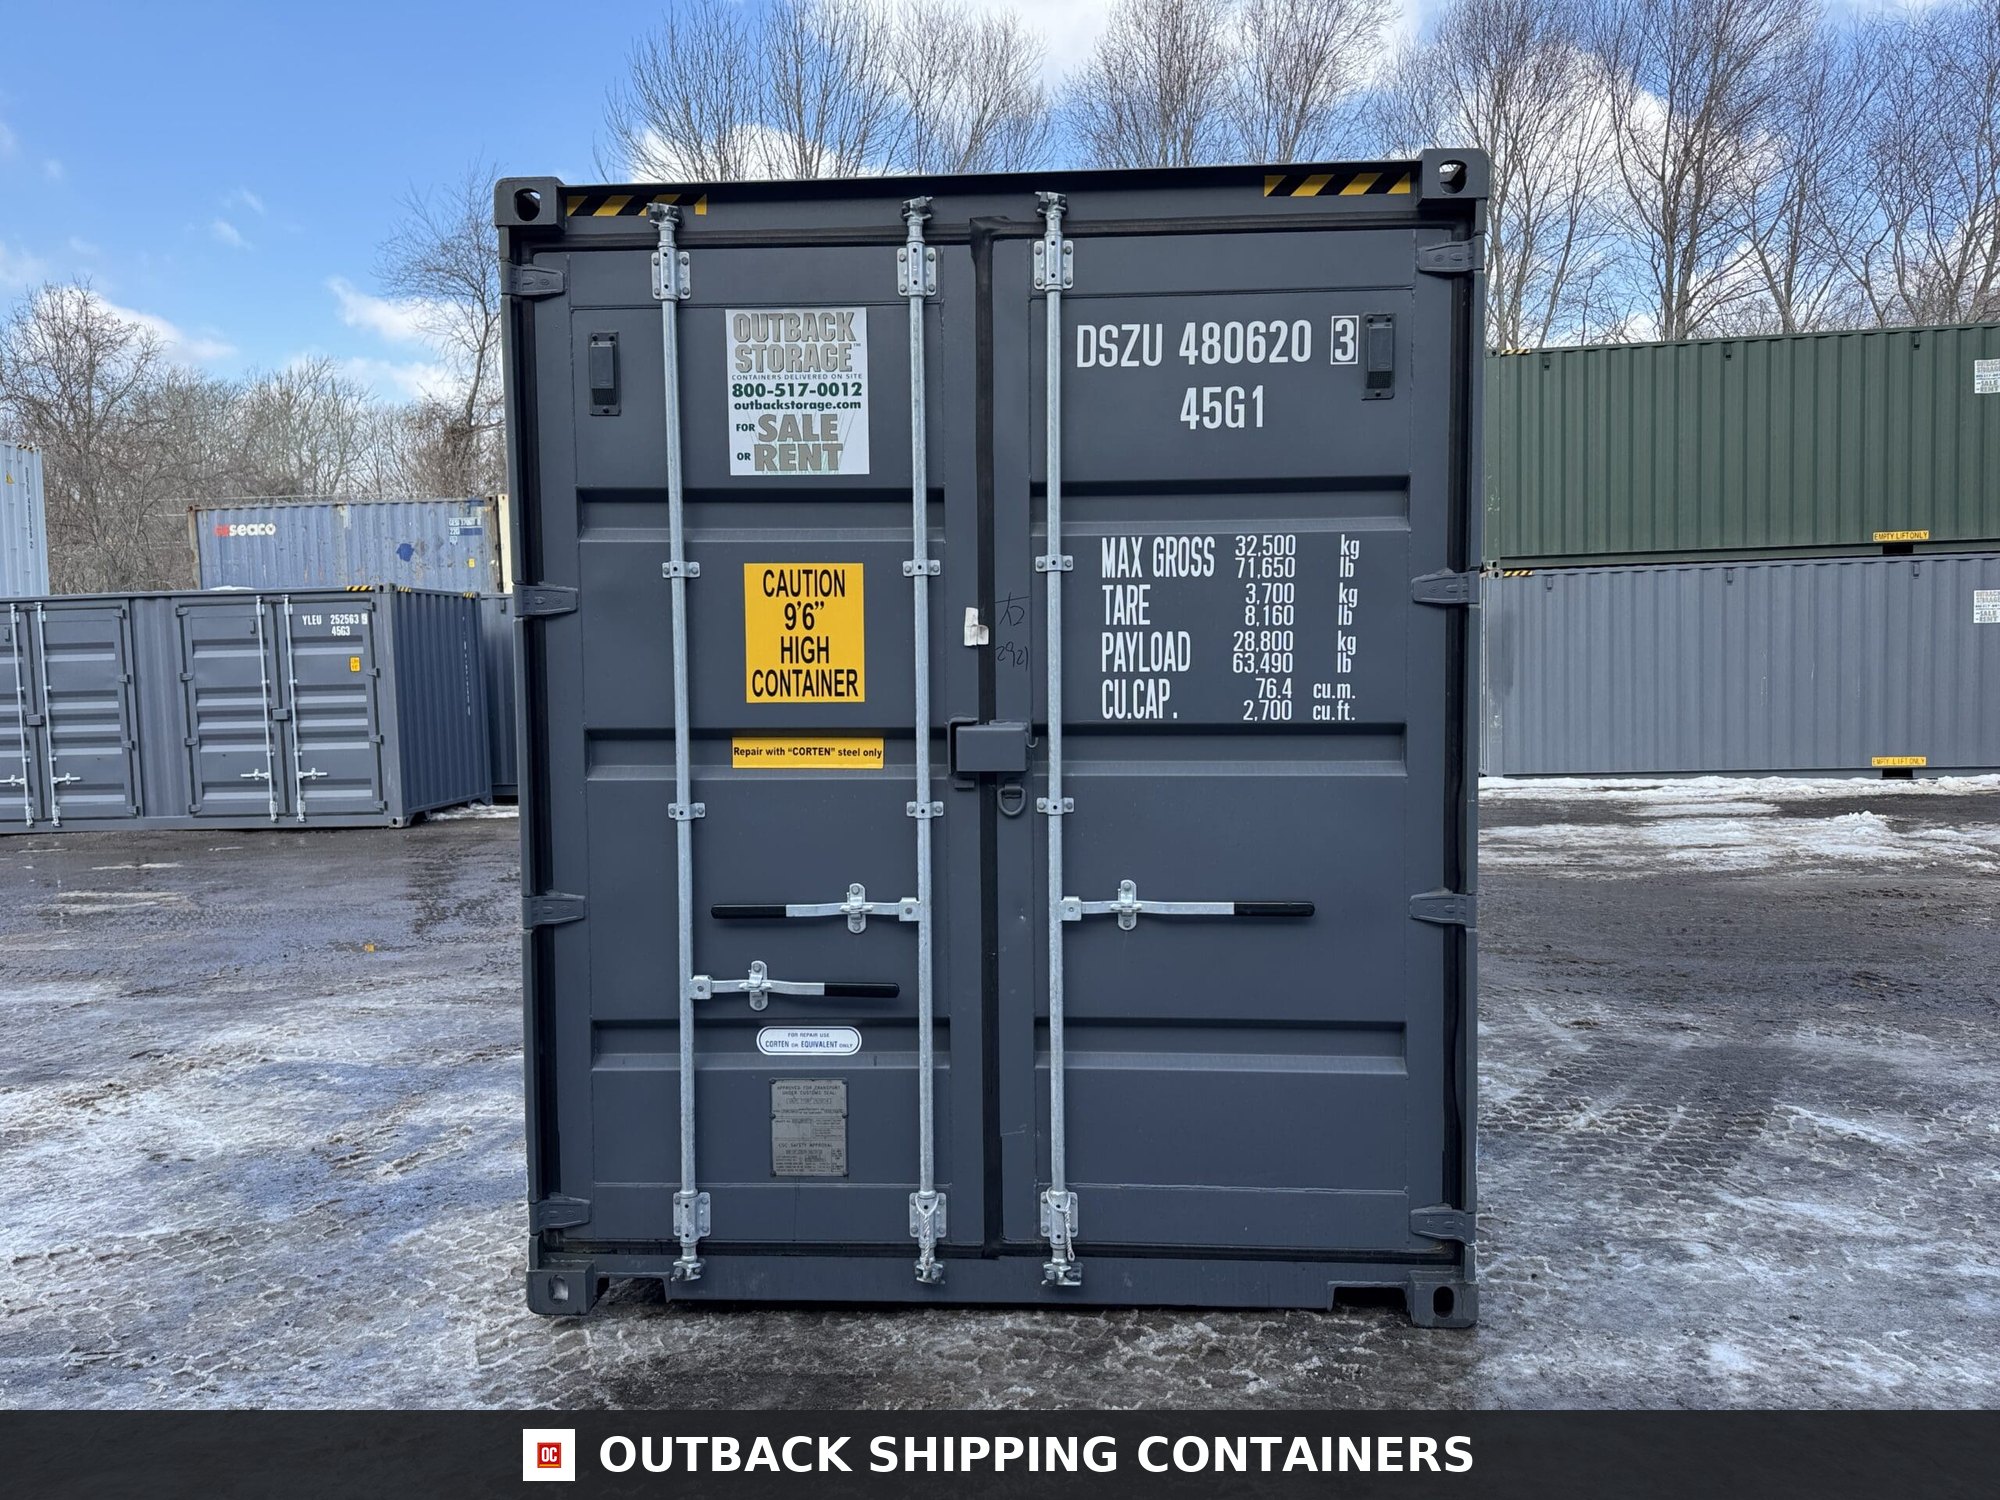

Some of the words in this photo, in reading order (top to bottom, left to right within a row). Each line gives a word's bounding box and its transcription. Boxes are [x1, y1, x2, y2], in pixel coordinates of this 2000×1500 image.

[732, 312, 856, 342] OUTBACK
[1076, 323, 1163, 368] DSZU
[1179, 320, 1312, 365] 480620
[1333, 318, 1356, 363] 3
[735, 343, 852, 373] STORAGE
[732, 382, 862, 397] 800-517-0012
[734, 400, 861, 411] outbackstorage.com
[1180, 385, 1265, 430] 45G1
[757, 414, 839, 442] SALE
[754, 444, 843, 471] RENT
[1102, 537, 1143, 578] MAX
[1153, 536, 1215, 577] GROSS
[1235, 535, 1296, 557] 32,500
[1341, 535, 1360, 559] kg
[1236, 557, 1296, 579] 71,650
[1340, 557, 1354, 578] lb
[763, 569, 845, 597] CAUTION
[1102, 584, 1151, 625] TARE
[1245, 583, 1295, 605] 3,700
[1339, 583, 1358, 608] kg
[1245, 605, 1294, 627] 8,160
[1338, 605, 1353, 625] lb
[302, 615, 322, 625] YLEU
[780, 636, 829, 664] HIGH
[1102, 631, 1191, 673] PAYLOAD
[1233, 631, 1294, 652] 28,800
[1337, 631, 1357, 655] kg
[1232, 653, 1293, 675] 63,490
[1337, 653, 1352, 673] lb
[752, 669, 858, 697] CONTAINER
[1102, 679, 1177, 719] CU.CAP.
[1255, 678, 1292, 699] 76.4
[1313, 683, 1355, 700] cu.m.
[1243, 700, 1292, 722] 2,700
[1312, 702, 1355, 721] cu.ft.
[734, 747, 762, 757] Repair
[766, 747, 785, 755] with
[838, 748, 860, 756] steel
[863, 748, 882, 758] only
